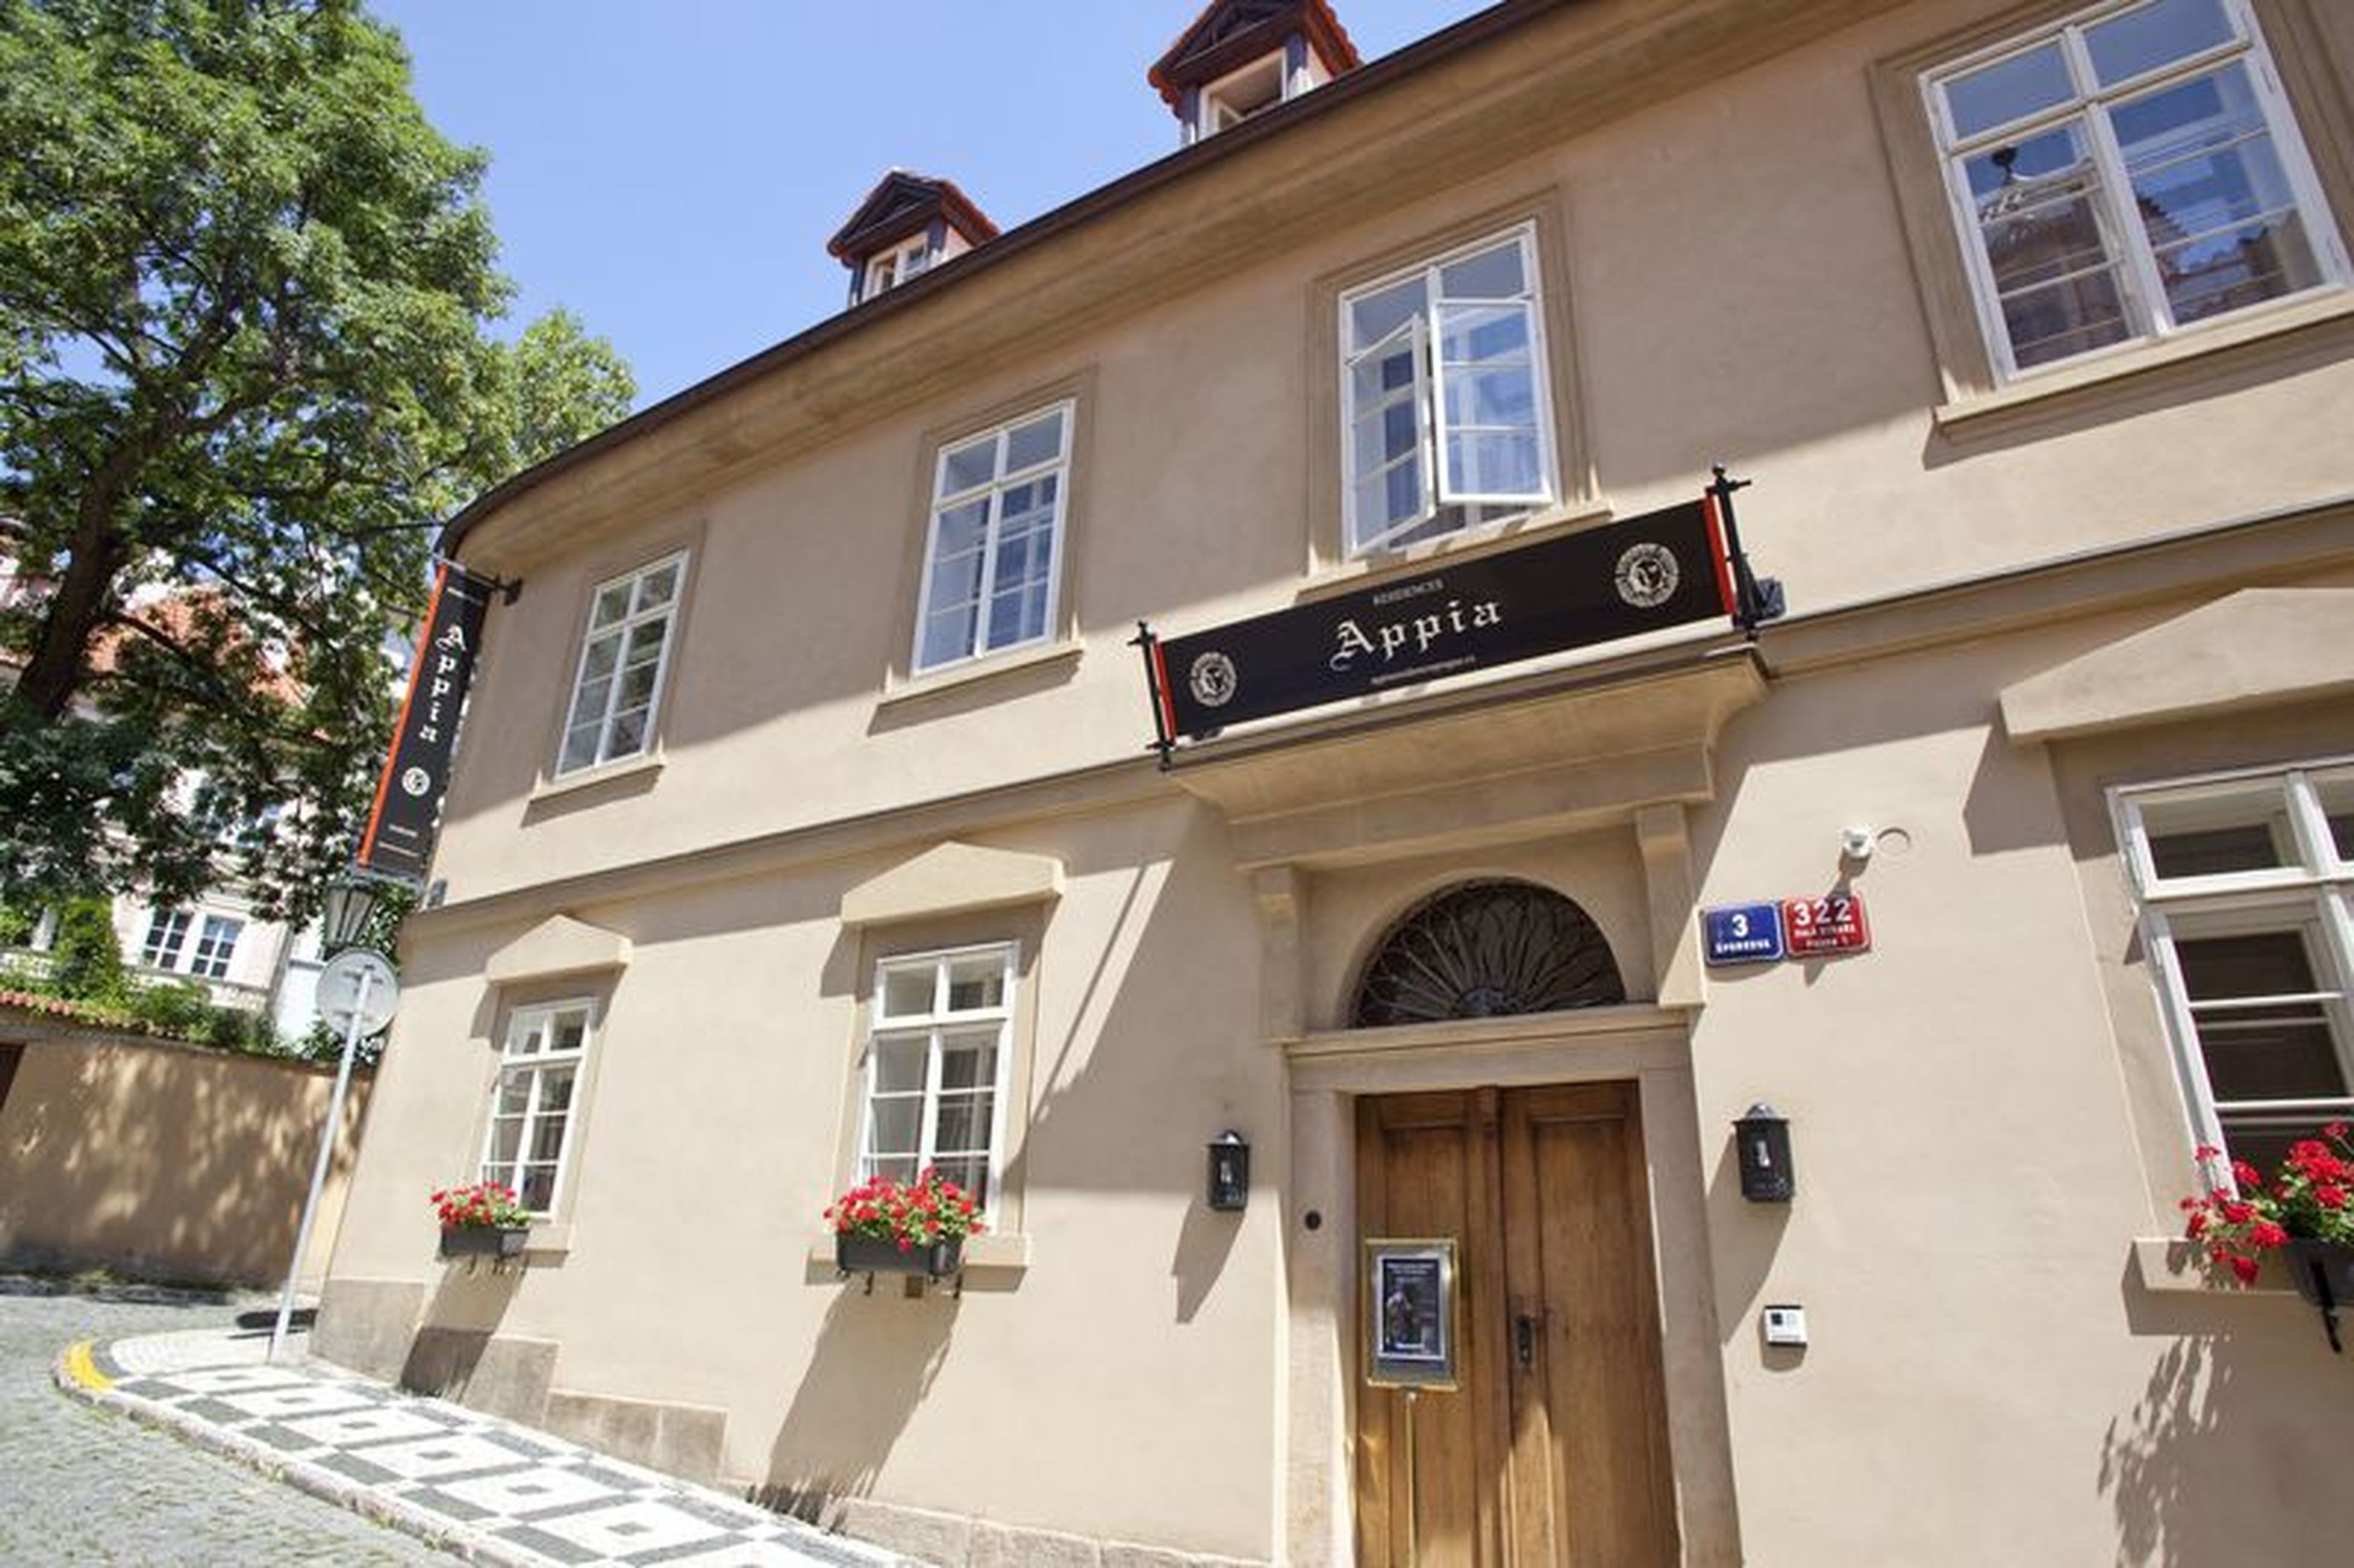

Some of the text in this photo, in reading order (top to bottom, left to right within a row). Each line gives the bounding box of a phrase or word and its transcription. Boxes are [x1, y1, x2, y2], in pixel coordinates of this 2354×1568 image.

[1329, 600, 1502, 672] Appia
[419, 623, 467, 743] Appia
[1732, 914, 1748, 938] 3
[1793, 899, 1852, 926] 322
